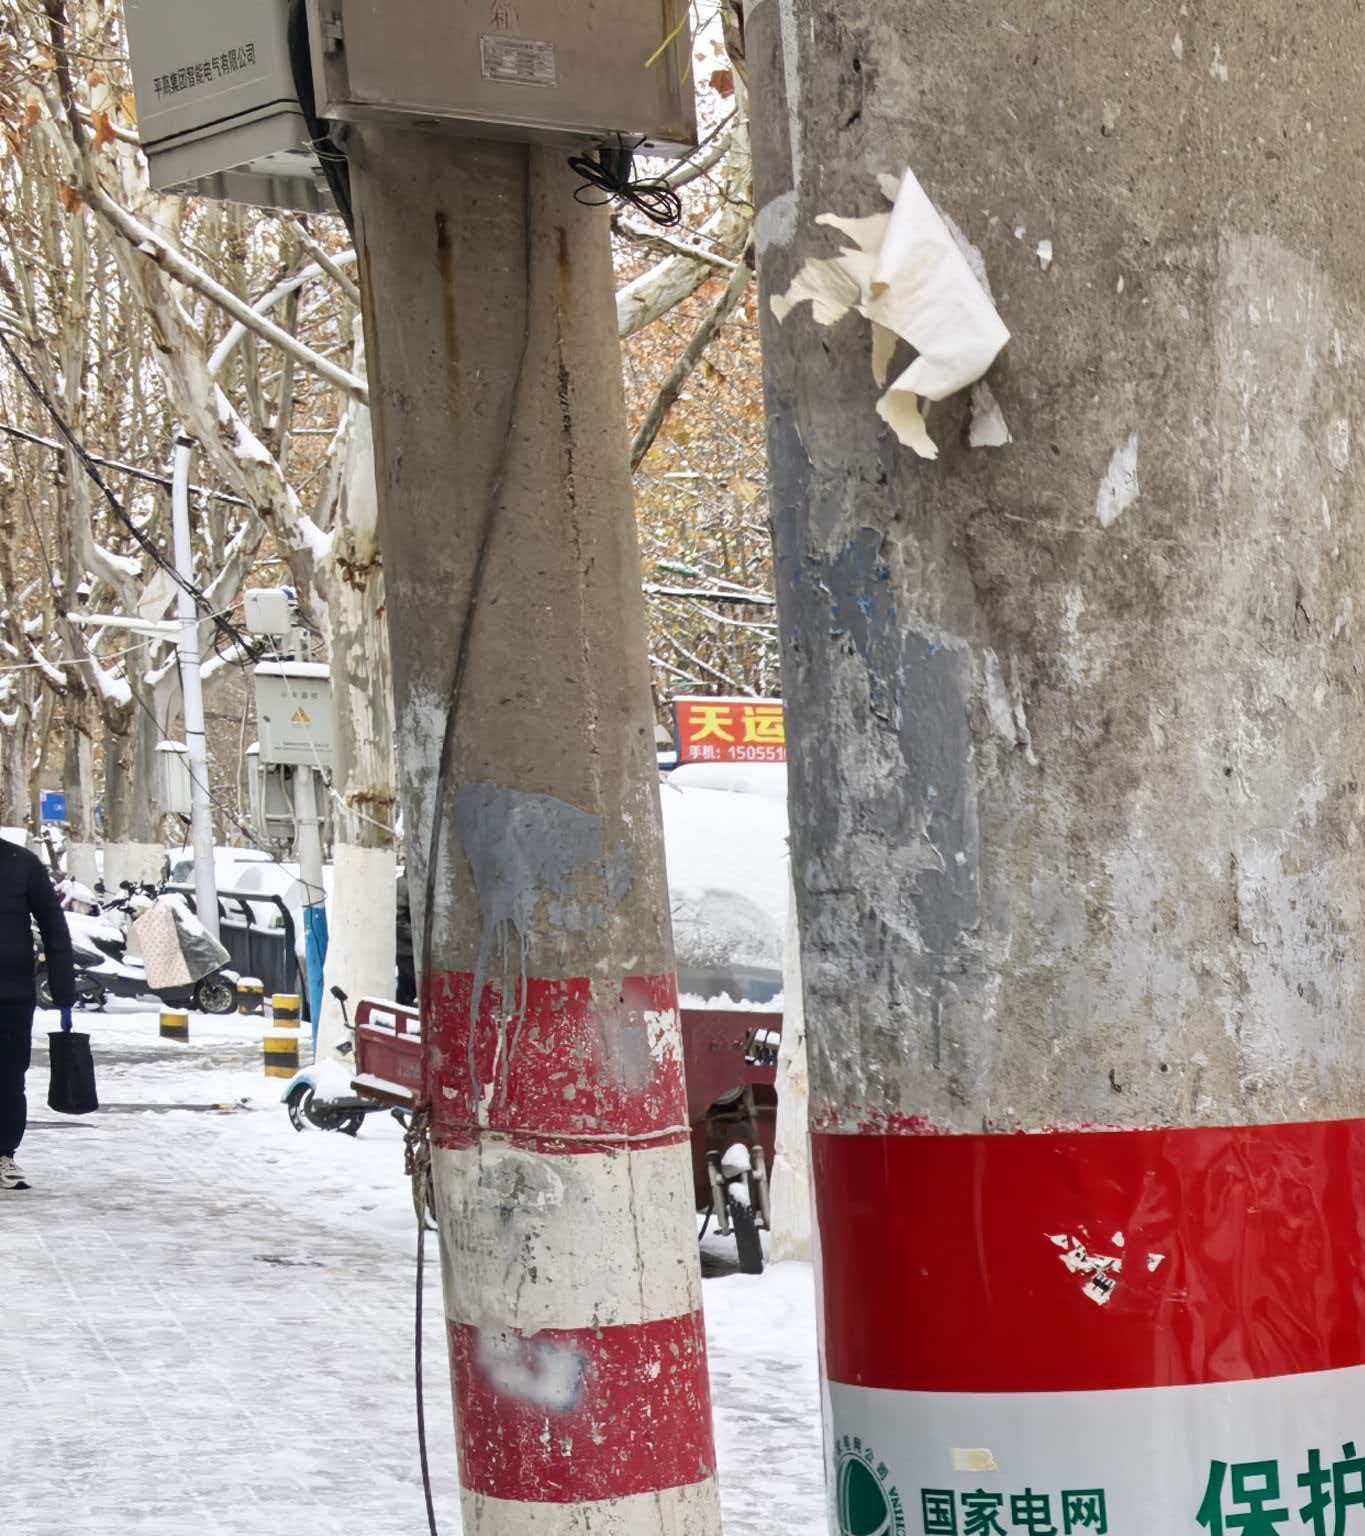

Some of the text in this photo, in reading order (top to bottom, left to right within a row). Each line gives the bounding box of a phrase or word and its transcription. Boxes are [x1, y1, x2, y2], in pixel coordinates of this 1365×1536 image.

[153, 42, 256, 102] 平高集团智能电气有限公司
[689, 705, 786, 743] 天运
